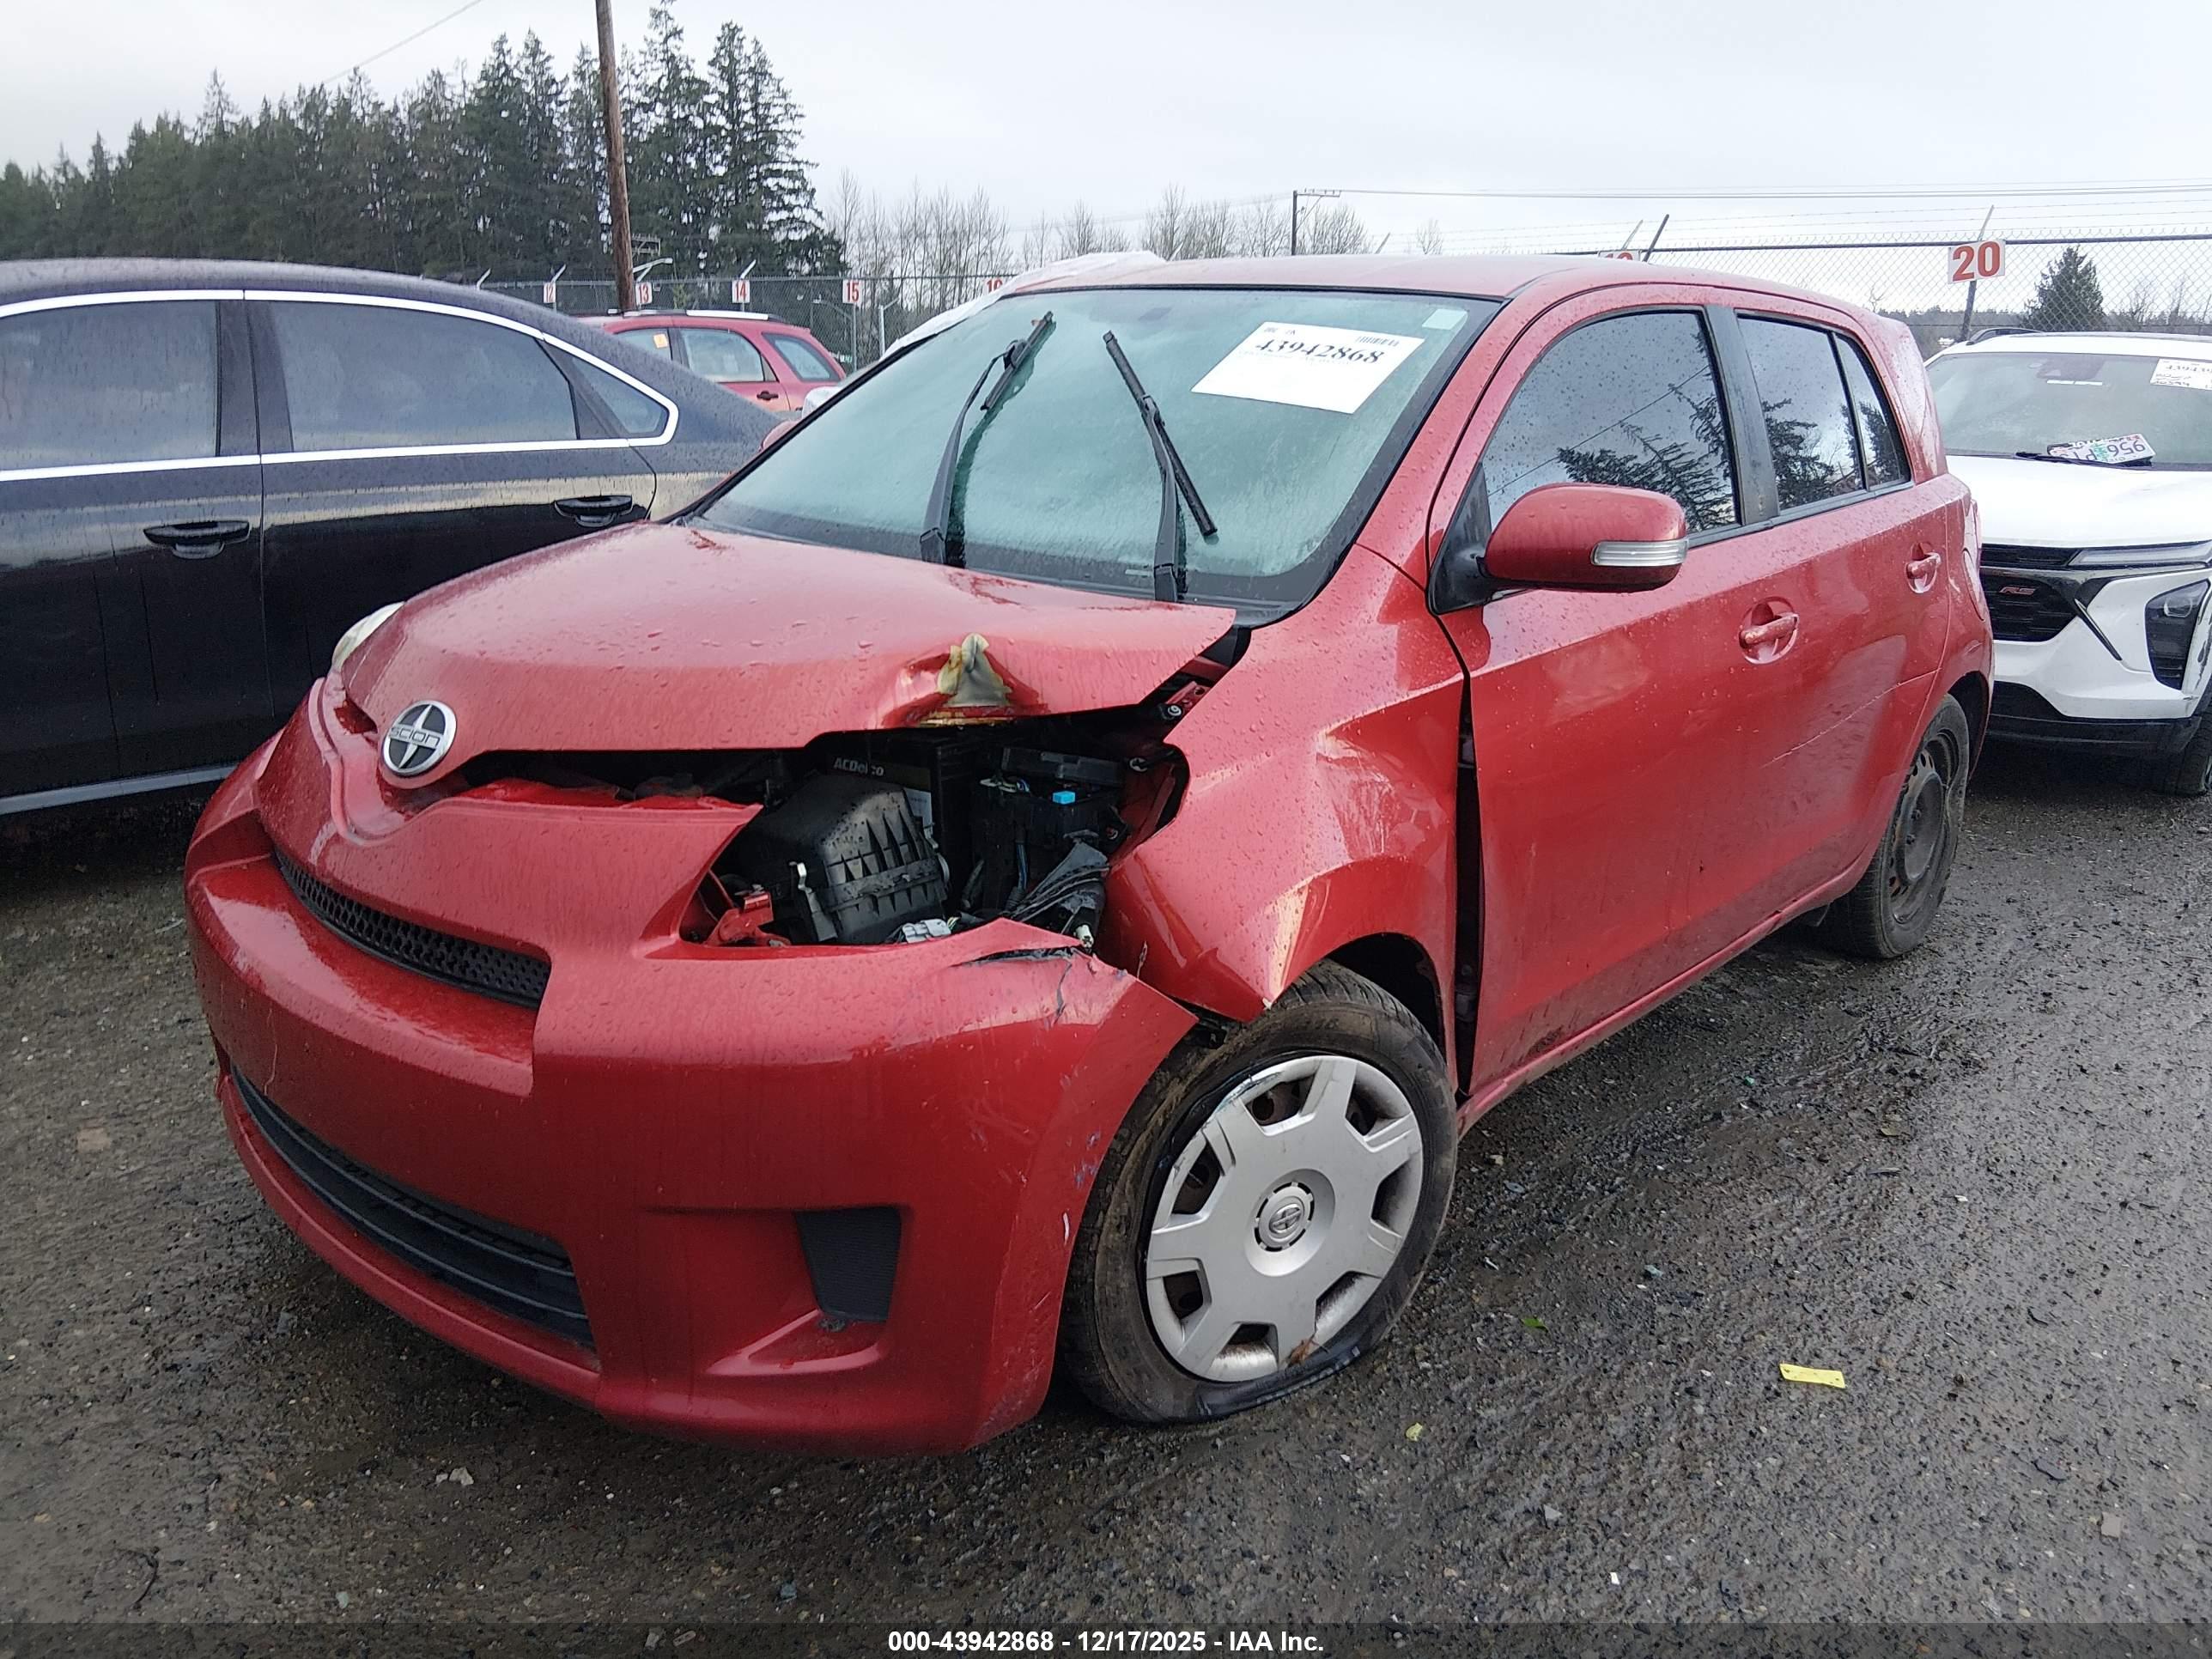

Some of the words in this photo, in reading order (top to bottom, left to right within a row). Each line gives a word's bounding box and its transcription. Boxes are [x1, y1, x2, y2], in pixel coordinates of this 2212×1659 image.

[1952, 240, 2001, 282] 20
[545, 285, 555, 301] 12
[637, 284, 650, 303] 13
[734, 283, 747, 301] 14
[846, 282, 860, 302] 15
[1255, 337, 1385, 364] 43942868
[1999, 586, 2037, 596] RS
